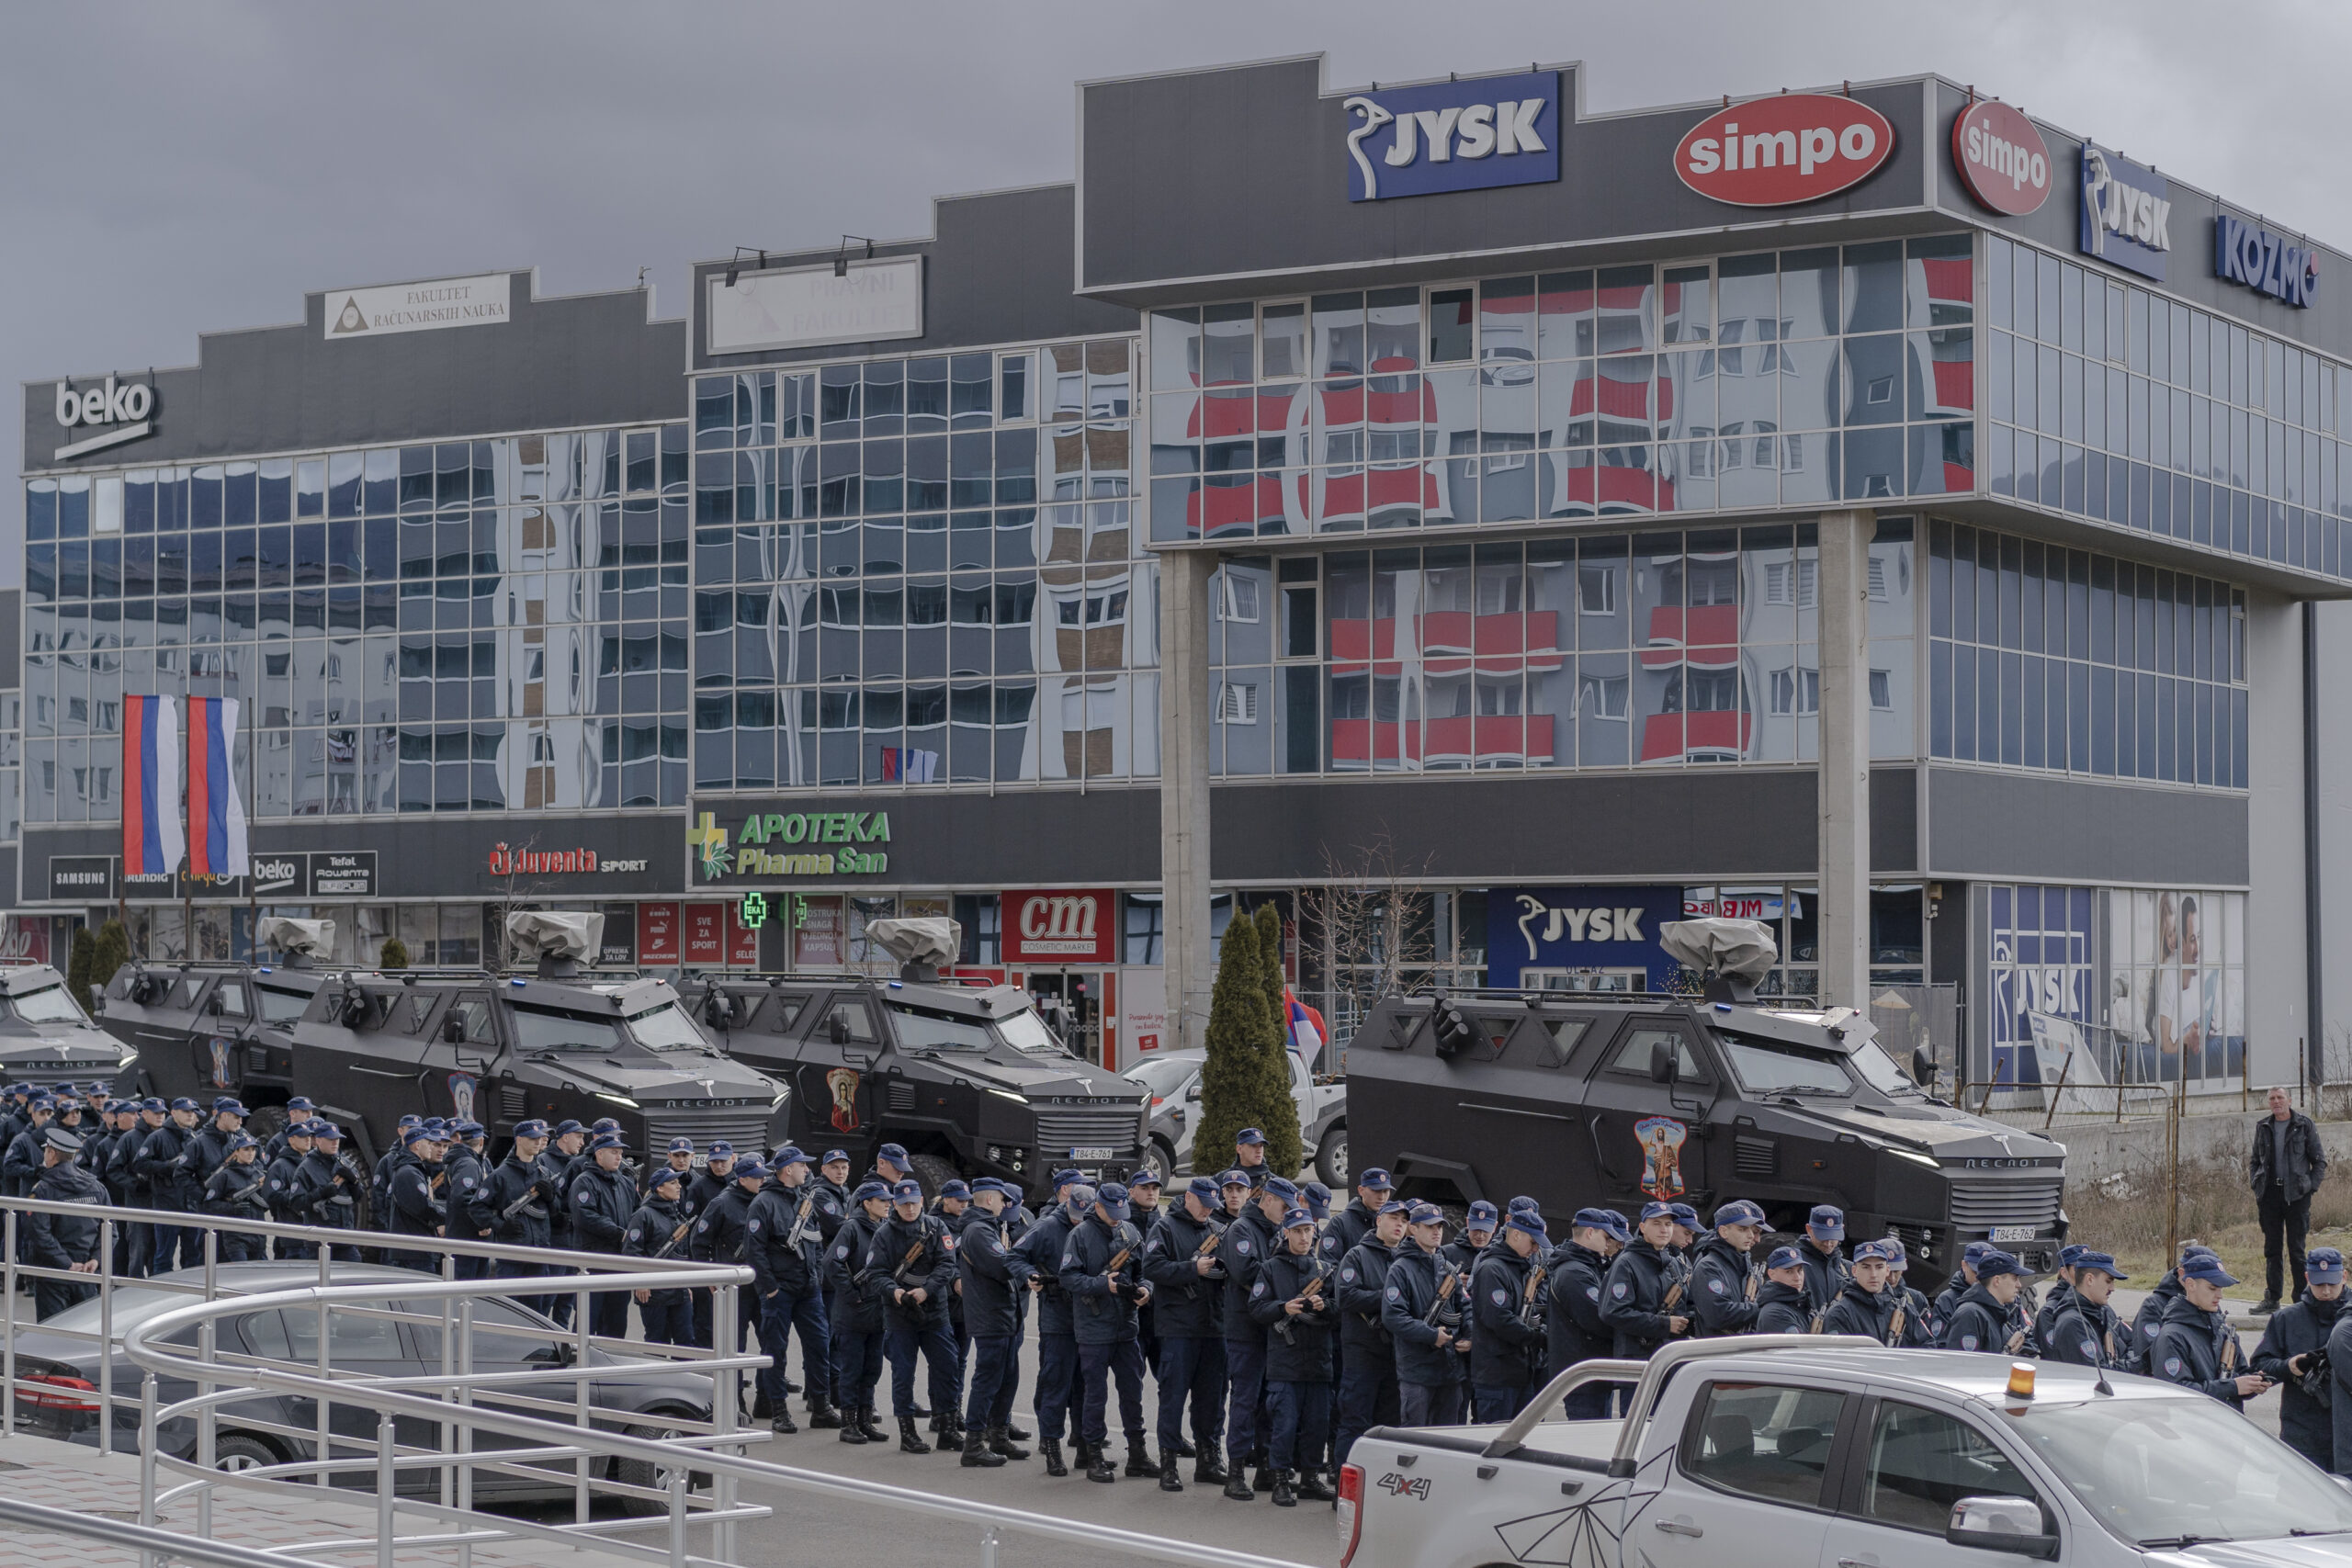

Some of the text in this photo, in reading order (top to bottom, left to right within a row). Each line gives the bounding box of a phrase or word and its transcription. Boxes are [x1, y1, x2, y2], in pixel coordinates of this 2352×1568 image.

[1385, 98, 1547, 167] JYSK
[1689, 123, 1875, 175] simpo
[1967, 119, 2046, 190] simpo
[2102, 180, 2171, 252] JYSK
[407, 286, 471, 305] FAKULTET
[374, 302, 504, 327] RAČUNARSKIH NAUKA
[56, 377, 152, 427] beko
[738, 812, 890, 843] APOTEKA
[254, 860, 296, 880] beko
[329, 856, 356, 866] Tefal
[514, 848, 648, 873] Juventa SPORT
[737, 846, 888, 874] Pharma San
[56, 872, 105, 885] SAMSUNG
[119, 873, 168, 883] RUNDIG
[696, 917, 712, 925] SVE
[800, 908, 842, 918] OSTRUKA
[807, 919, 832, 929] SNAGA
[1020, 897, 1097, 939] cm
[698, 929, 709, 937] ZA
[1542, 908, 1645, 942] JYSK
[692, 941, 717, 950] SPORT
[1022, 942, 1094, 952] COSMETIC MARKET
[2017, 968, 2079, 1014] JYSK
[1076, 1149, 1111, 1158] T84-E-761
[1996, 1228, 2034, 1240] T84-E-762
[1377, 1472, 1431, 1501] 4x4
